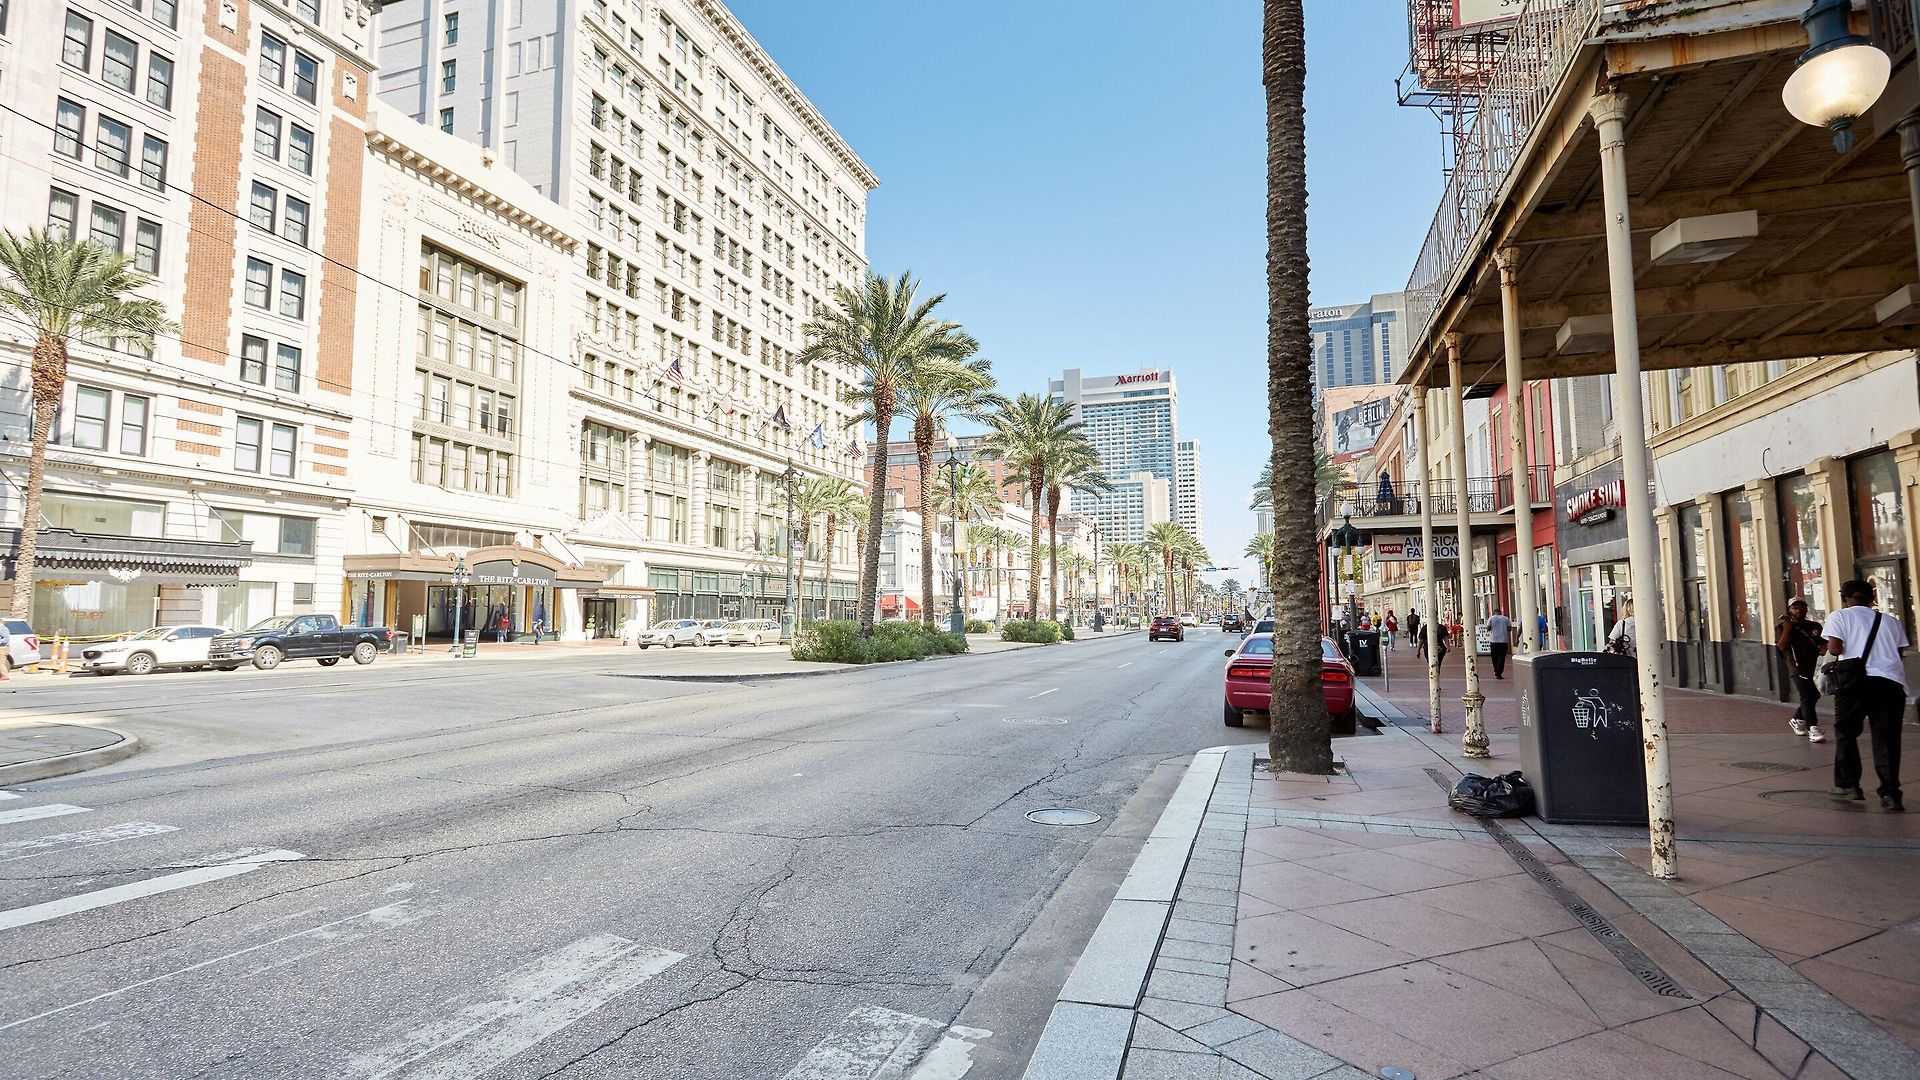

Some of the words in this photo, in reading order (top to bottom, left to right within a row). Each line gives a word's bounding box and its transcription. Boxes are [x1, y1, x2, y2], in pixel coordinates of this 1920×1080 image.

[1114, 372, 1158, 386] Marriott
[1358, 405, 1385, 425] BERLIN
[1566, 489, 1597, 519] SMOKE
[1404, 536, 1459, 547] AMRICA
[1407, 547, 1459, 558] FAHION
[479, 575, 496, 583] THE
